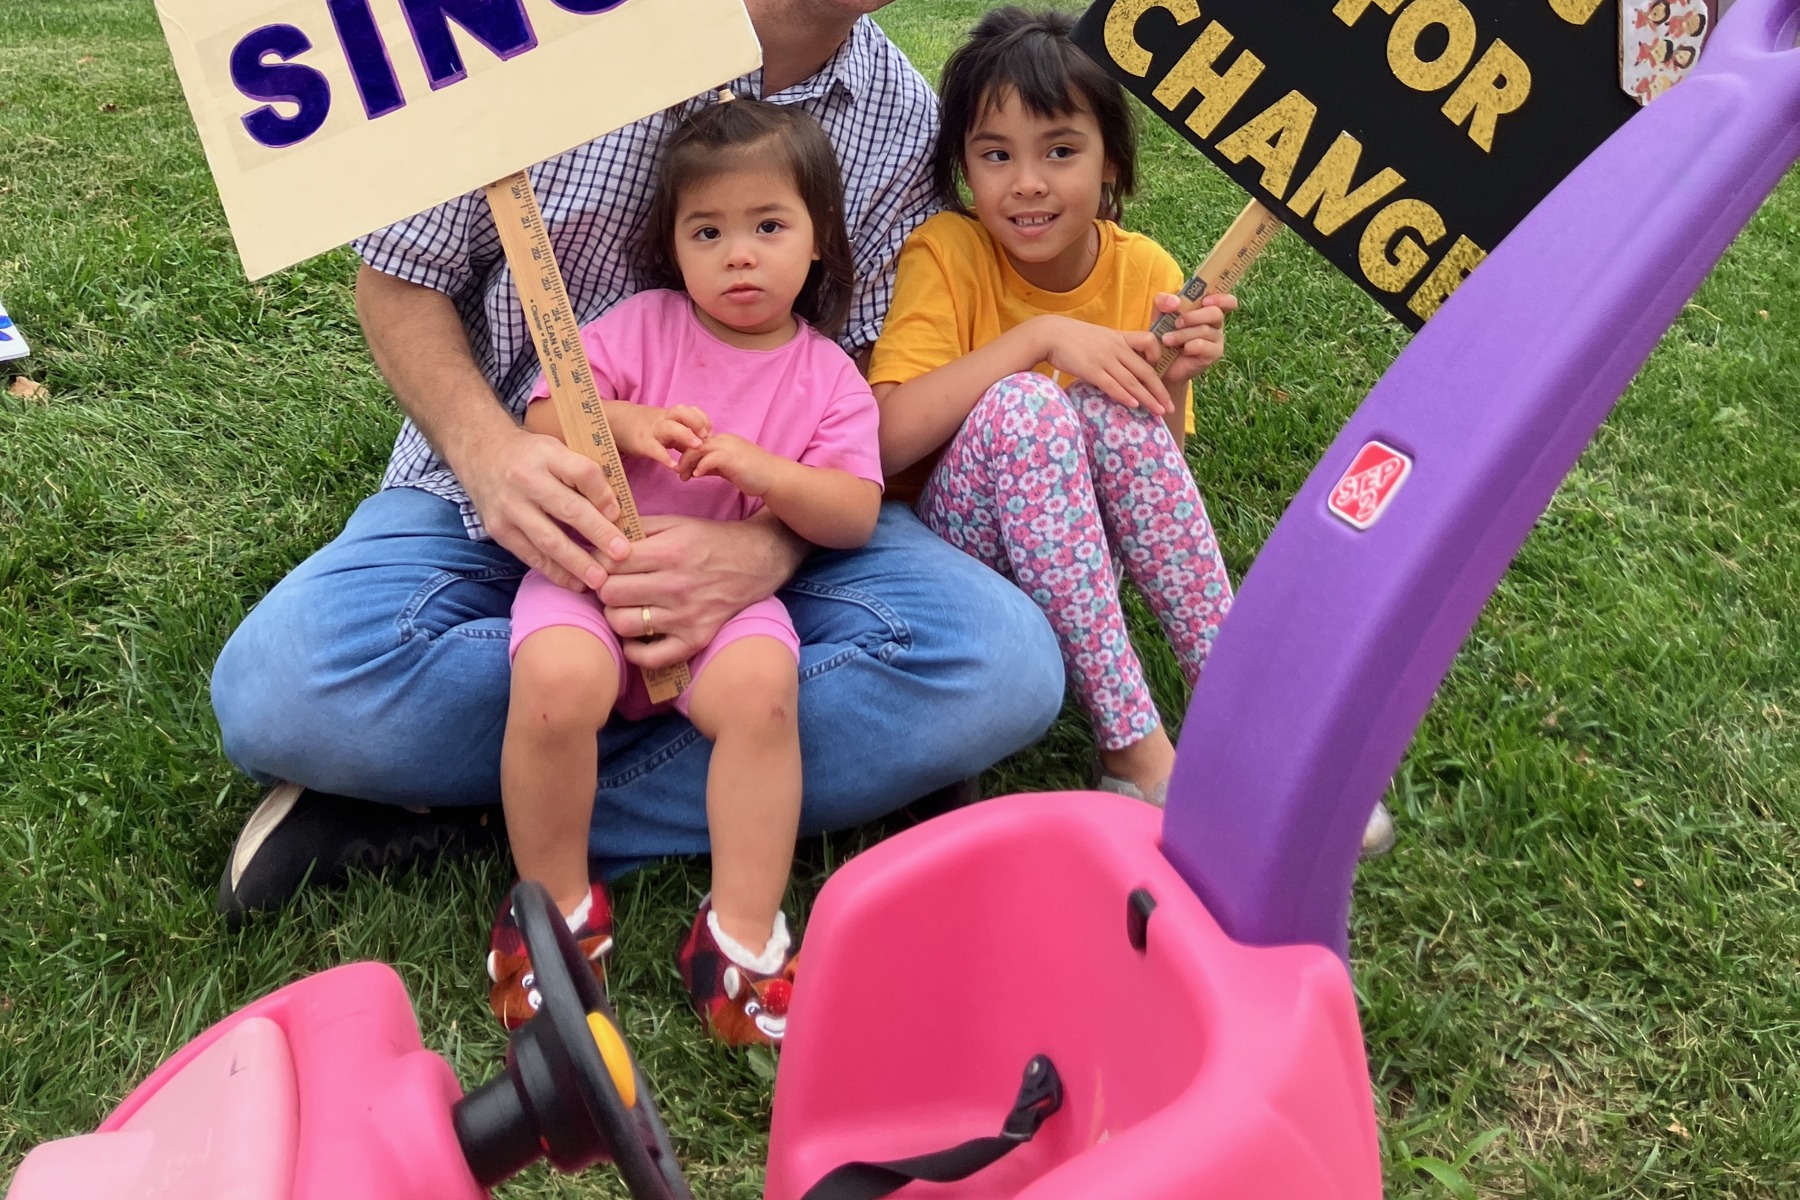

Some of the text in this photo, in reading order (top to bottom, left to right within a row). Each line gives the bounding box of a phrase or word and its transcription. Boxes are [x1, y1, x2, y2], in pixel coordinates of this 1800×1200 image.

[521, 216, 532, 230] 21
[531, 246, 542, 261] 22
[551, 307, 562, 321] 24
[543, 313, 563, 360] CLEAN UP
[531, 304, 561, 388] Cleaner Rags Gloves
[561, 338, 572, 352] 25
[571, 369, 582, 384] 26
[582, 401, 593, 414] 27
[1335, 456, 1401, 507] STEP
